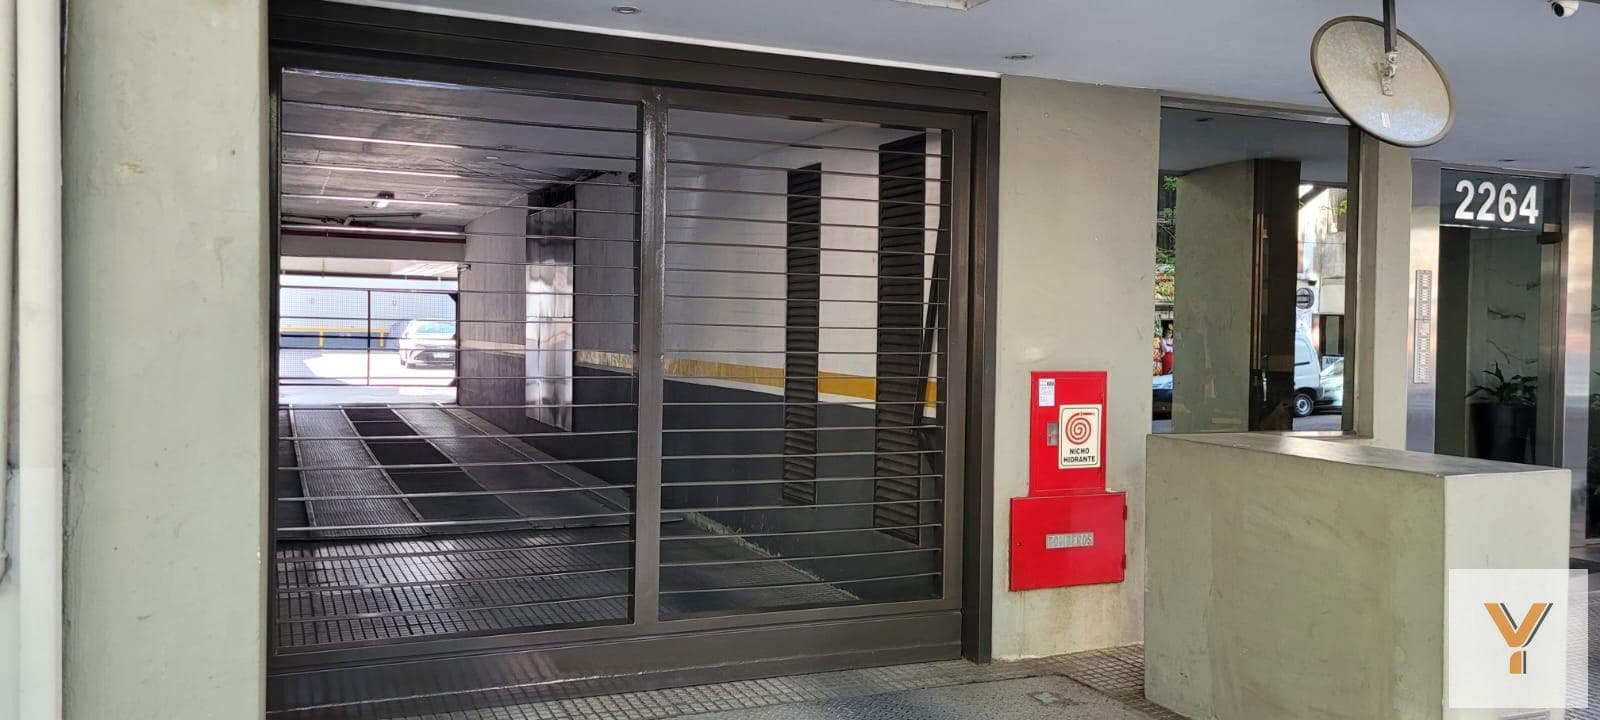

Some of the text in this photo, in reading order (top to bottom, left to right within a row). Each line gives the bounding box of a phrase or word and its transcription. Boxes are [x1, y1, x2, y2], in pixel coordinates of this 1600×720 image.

[1455, 179, 1539, 224] 2264
[1069, 447, 1090, 455] NICHO
[1063, 455, 1096, 463] HIDRANTE
